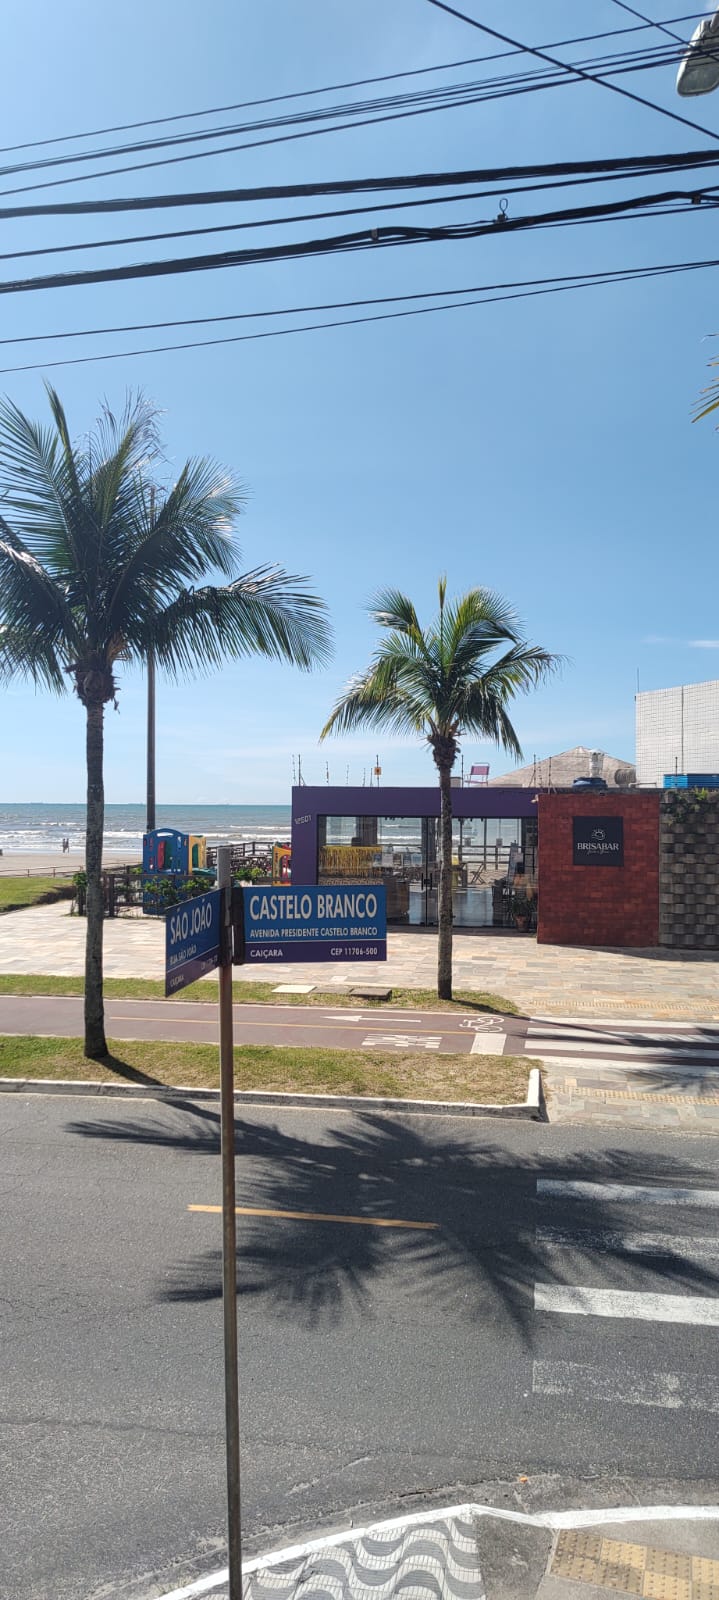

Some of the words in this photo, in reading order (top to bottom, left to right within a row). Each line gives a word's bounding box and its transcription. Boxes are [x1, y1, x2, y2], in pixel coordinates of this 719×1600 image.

[577, 842, 619, 850] BRISABAR
[250, 894, 312, 920] CASTELO
[317, 893, 377, 919] BRANCO
[170, 907, 189, 945] SÃO
[190, 899, 212, 937] JOÃO
[250, 929, 280, 938] AVENIDA
[281, 927, 319, 937] PRESIDENTE
[320, 927, 348, 937] CASTELO
[350, 926, 378, 936] BRANCO
[250, 949, 283, 959] CAIÇARA
[330, 948, 343, 956] CEP
[344, 947, 378, 956] 11706-500
